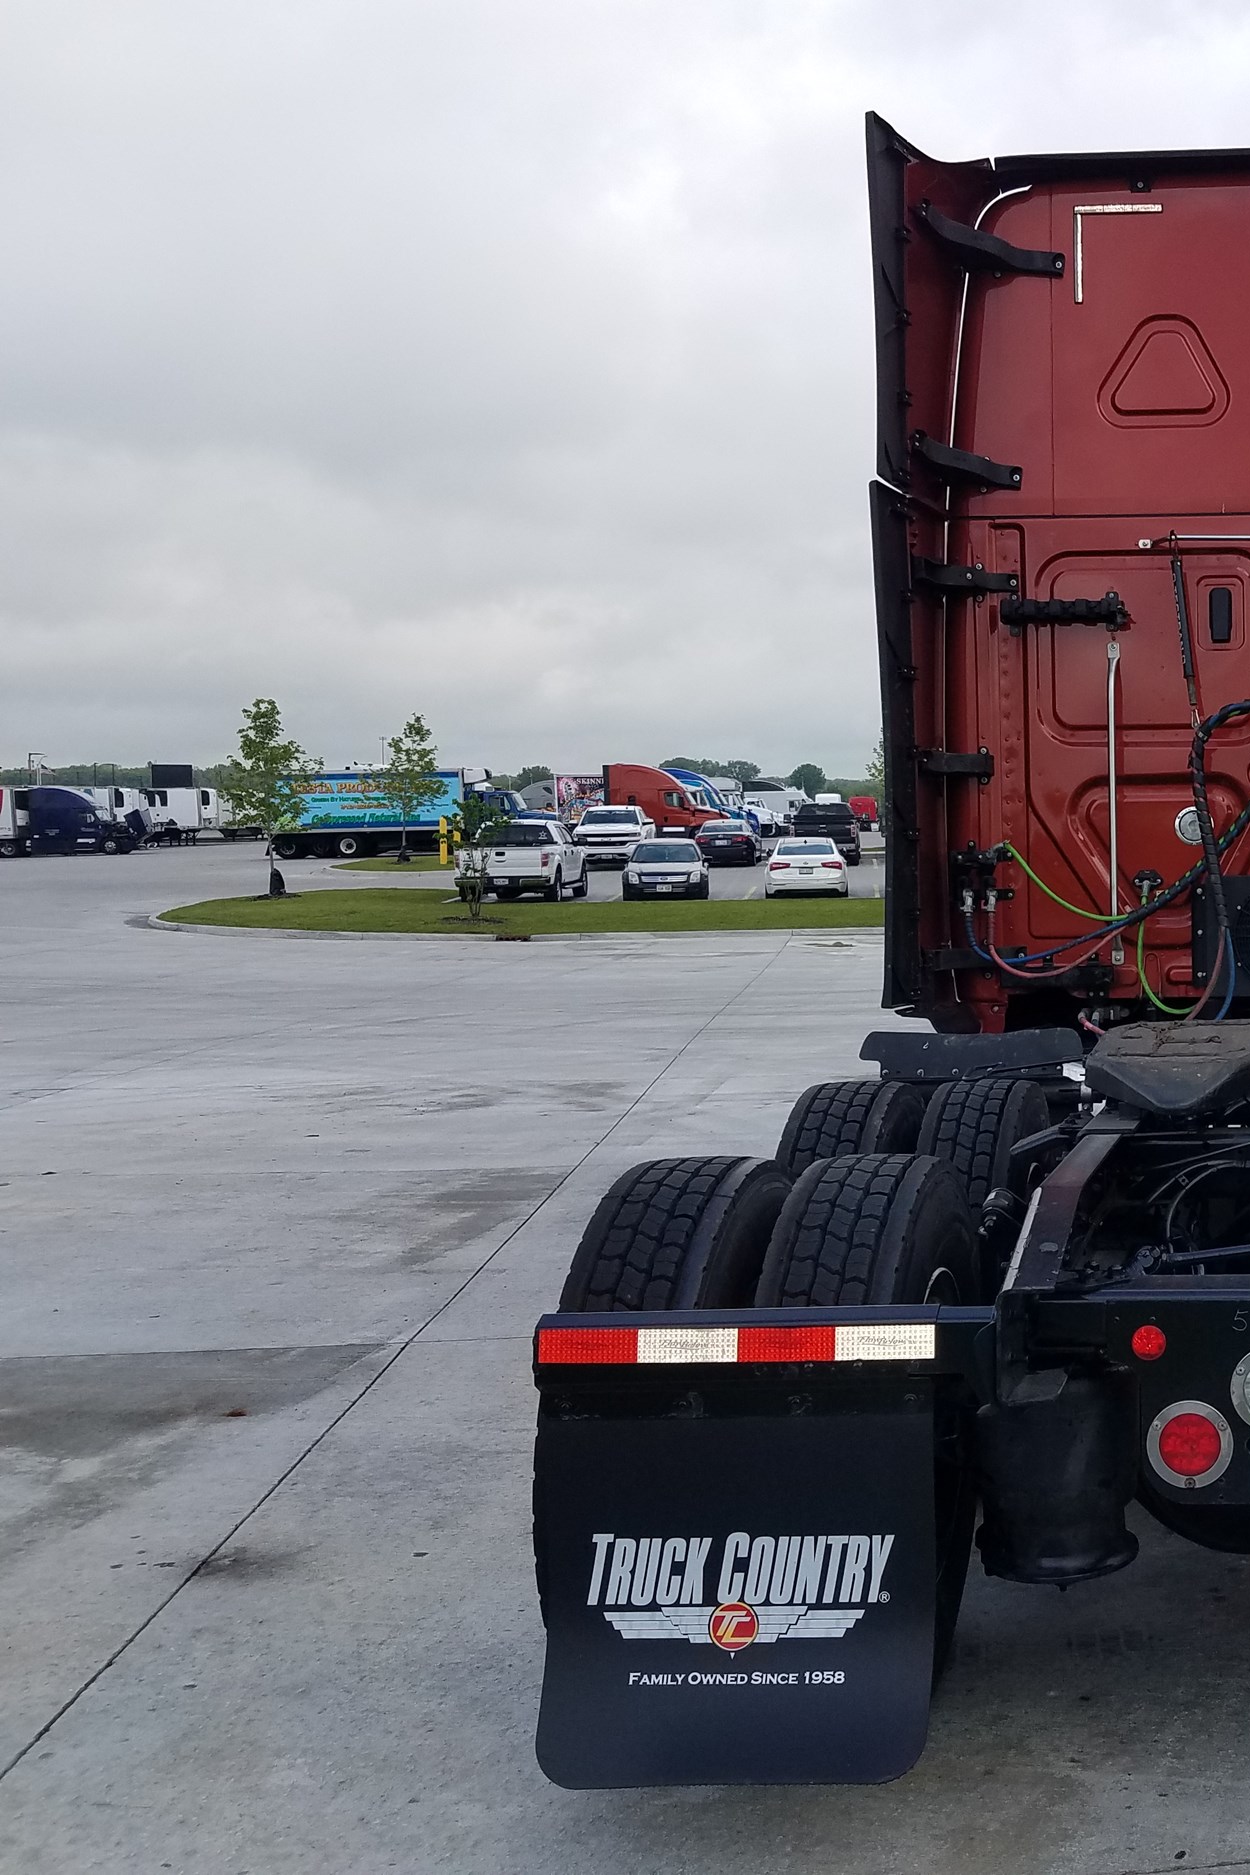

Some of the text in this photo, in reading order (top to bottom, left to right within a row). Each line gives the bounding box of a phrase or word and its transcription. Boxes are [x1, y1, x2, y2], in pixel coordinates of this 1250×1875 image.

[587, 1532, 895, 1606] TRUCK COUNTRY
[628, 1671, 846, 1685] FAMILY OWNED SINCE 1958
